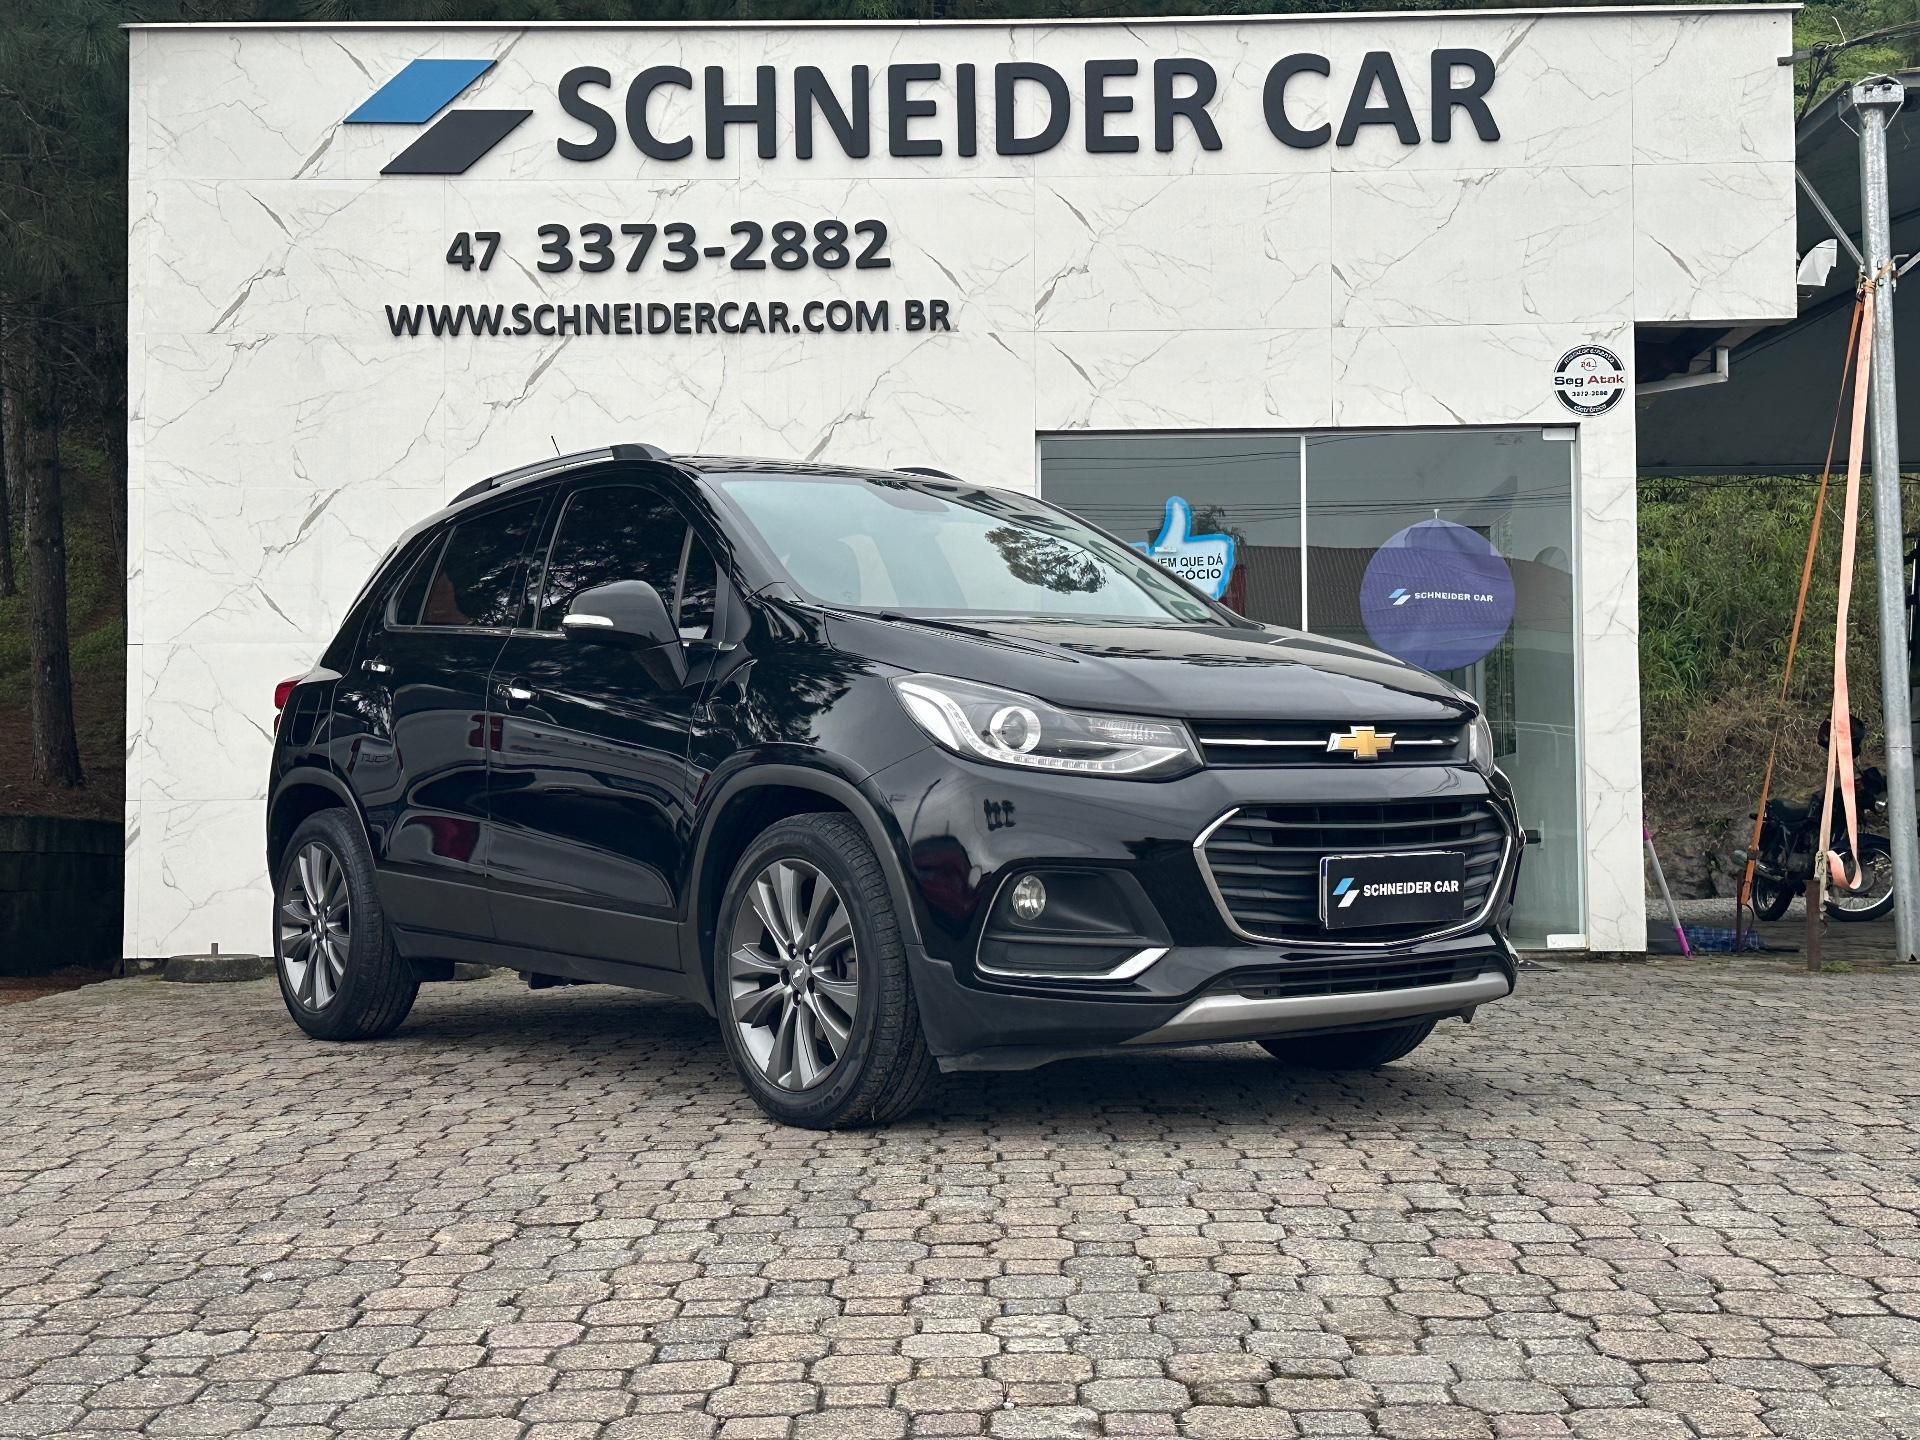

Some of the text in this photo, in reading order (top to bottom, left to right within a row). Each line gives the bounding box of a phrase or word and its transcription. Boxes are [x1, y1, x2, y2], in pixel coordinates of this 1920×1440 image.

[557, 48, 1501, 163] SCHNEIDER CAR
[445, 219, 892, 273] 47 3373-2882
[384, 299, 951, 337] WWW.SCHNEIDERCAR.COM BR
[1554, 374, 1625, 387] Seg Atak
[1157, 552, 1224, 568] EM QUE DÁ
[1414, 592, 1494, 602] SCHNEIDER CAR
[1363, 880, 1460, 897] SCHNEIDER CAR
